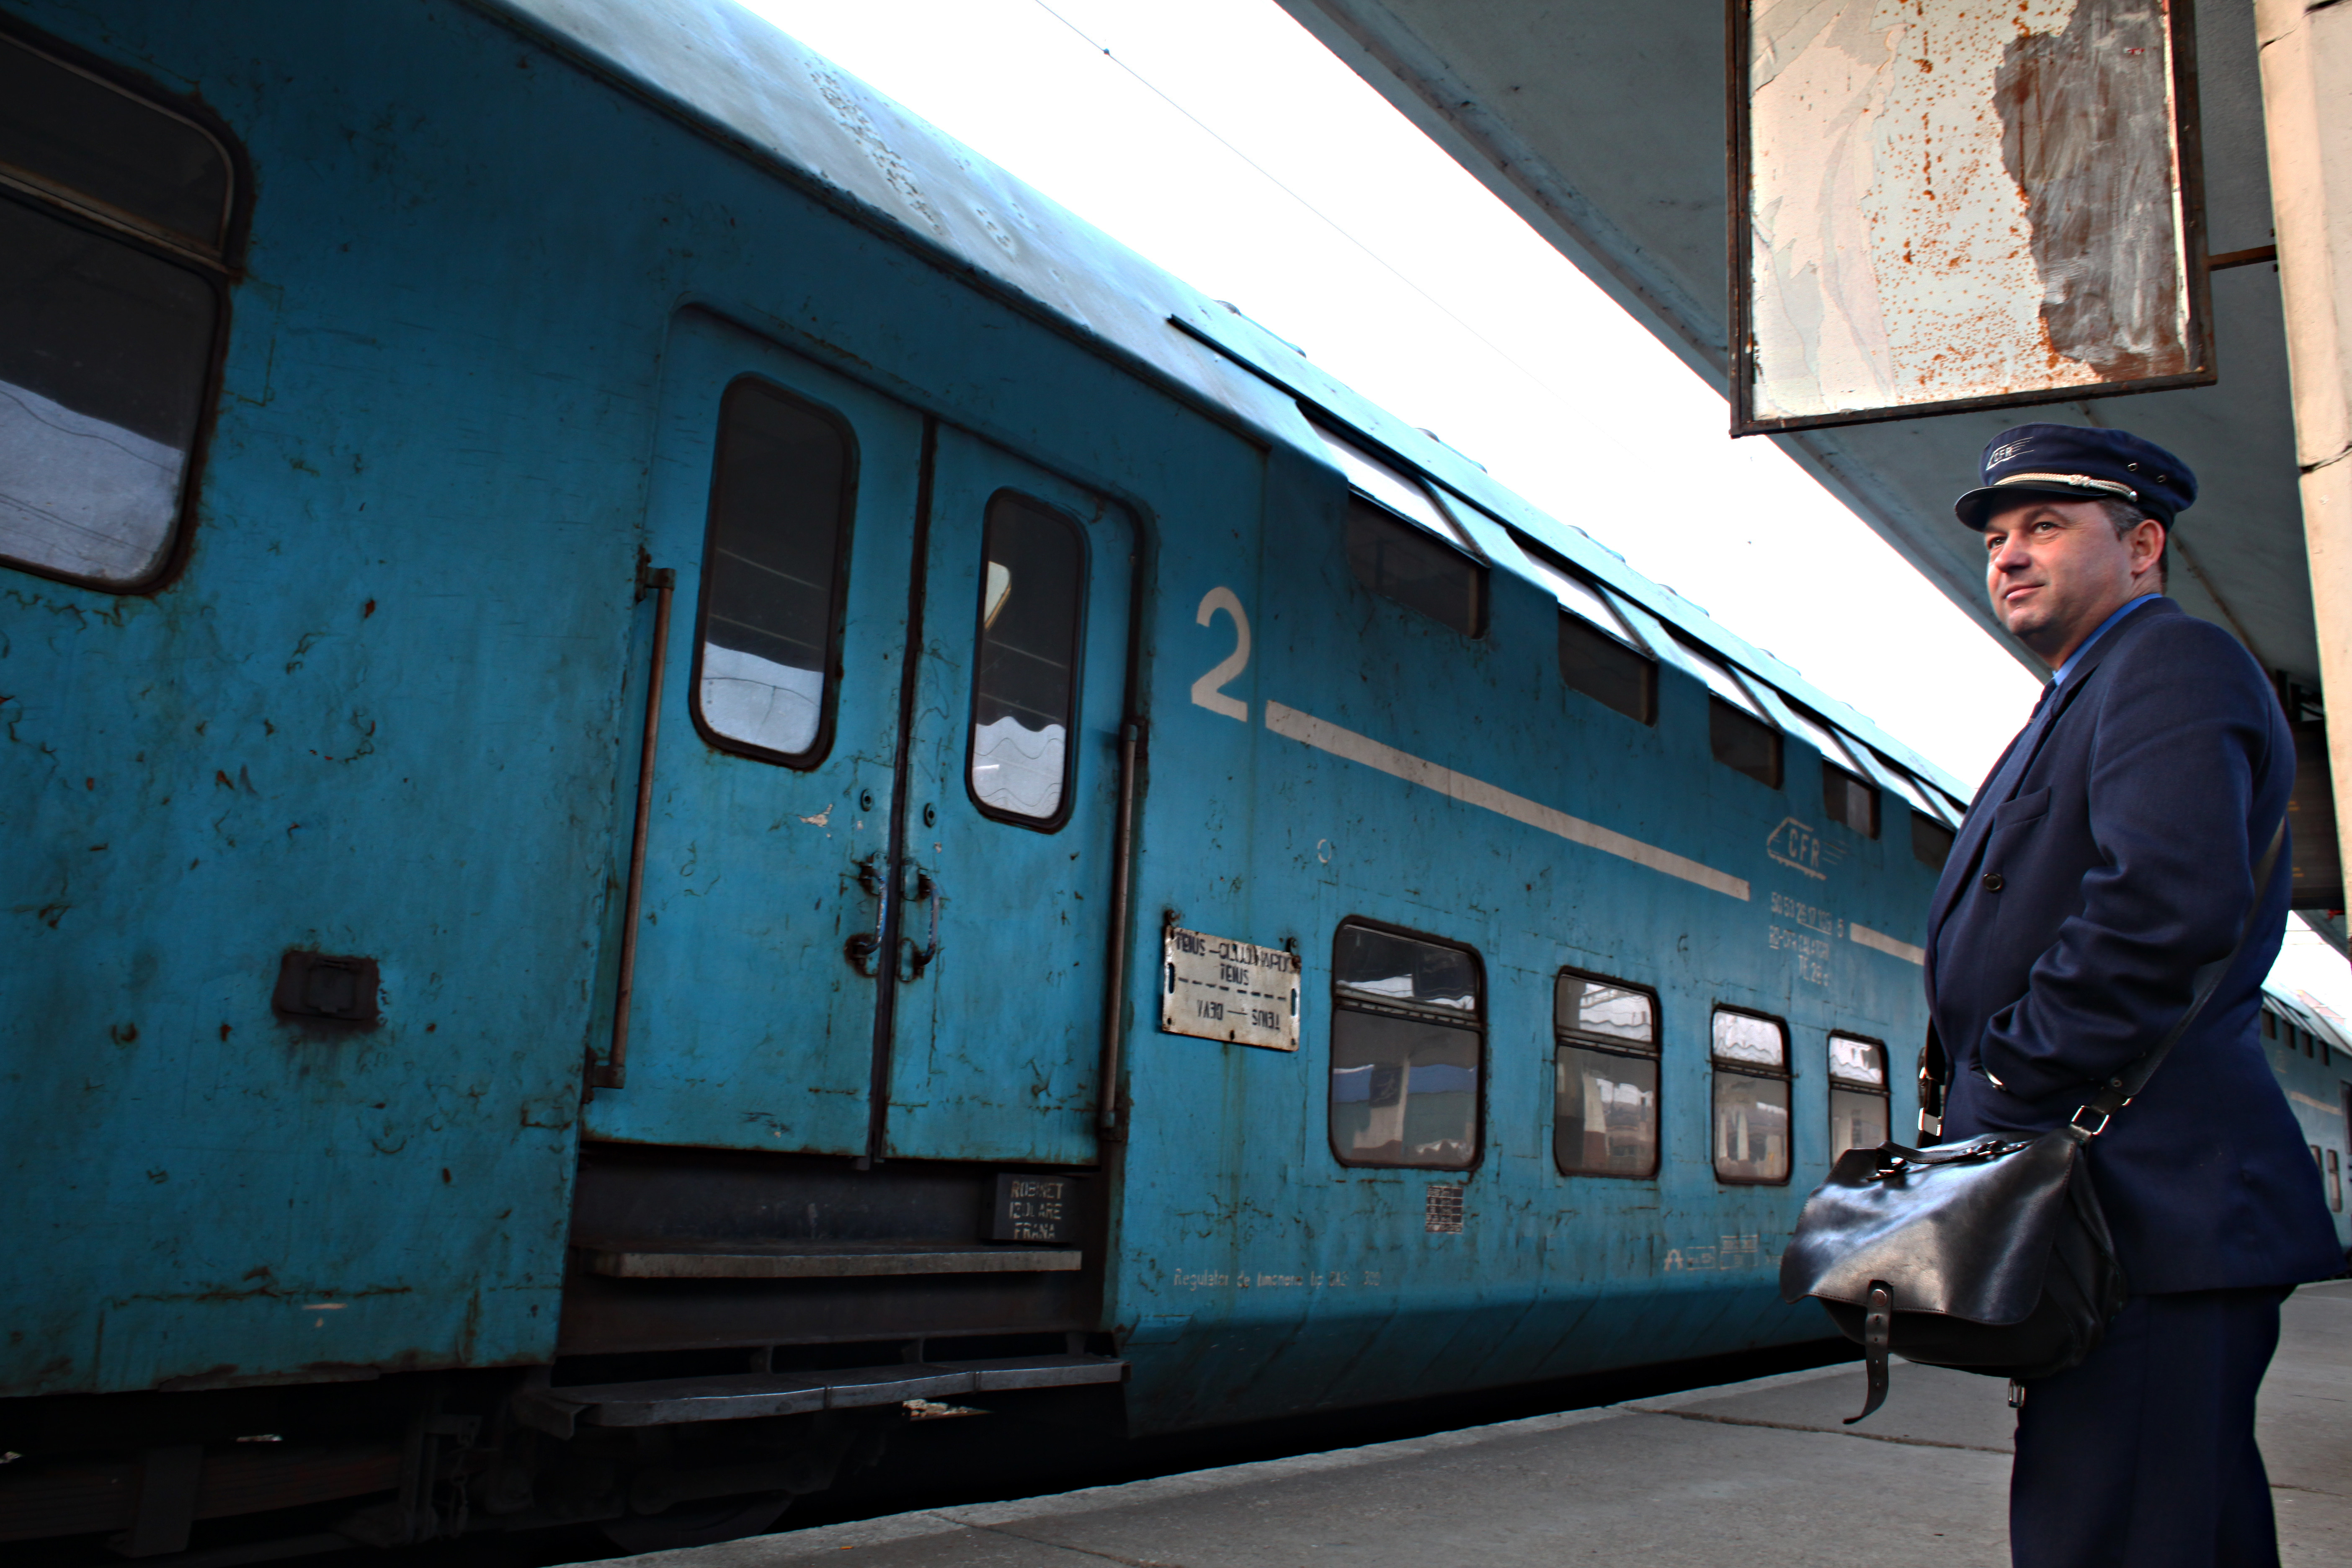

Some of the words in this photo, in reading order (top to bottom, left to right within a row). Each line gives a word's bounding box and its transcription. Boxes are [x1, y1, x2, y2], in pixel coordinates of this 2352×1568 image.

[1994, 447, 2012, 462] CFR
[1191, 586, 1251, 723] 2
[1789, 828, 1820, 867] CFR
[1174, 1268, 1229, 1291] Regulator
[1237, 1270, 1251, 1288] de
